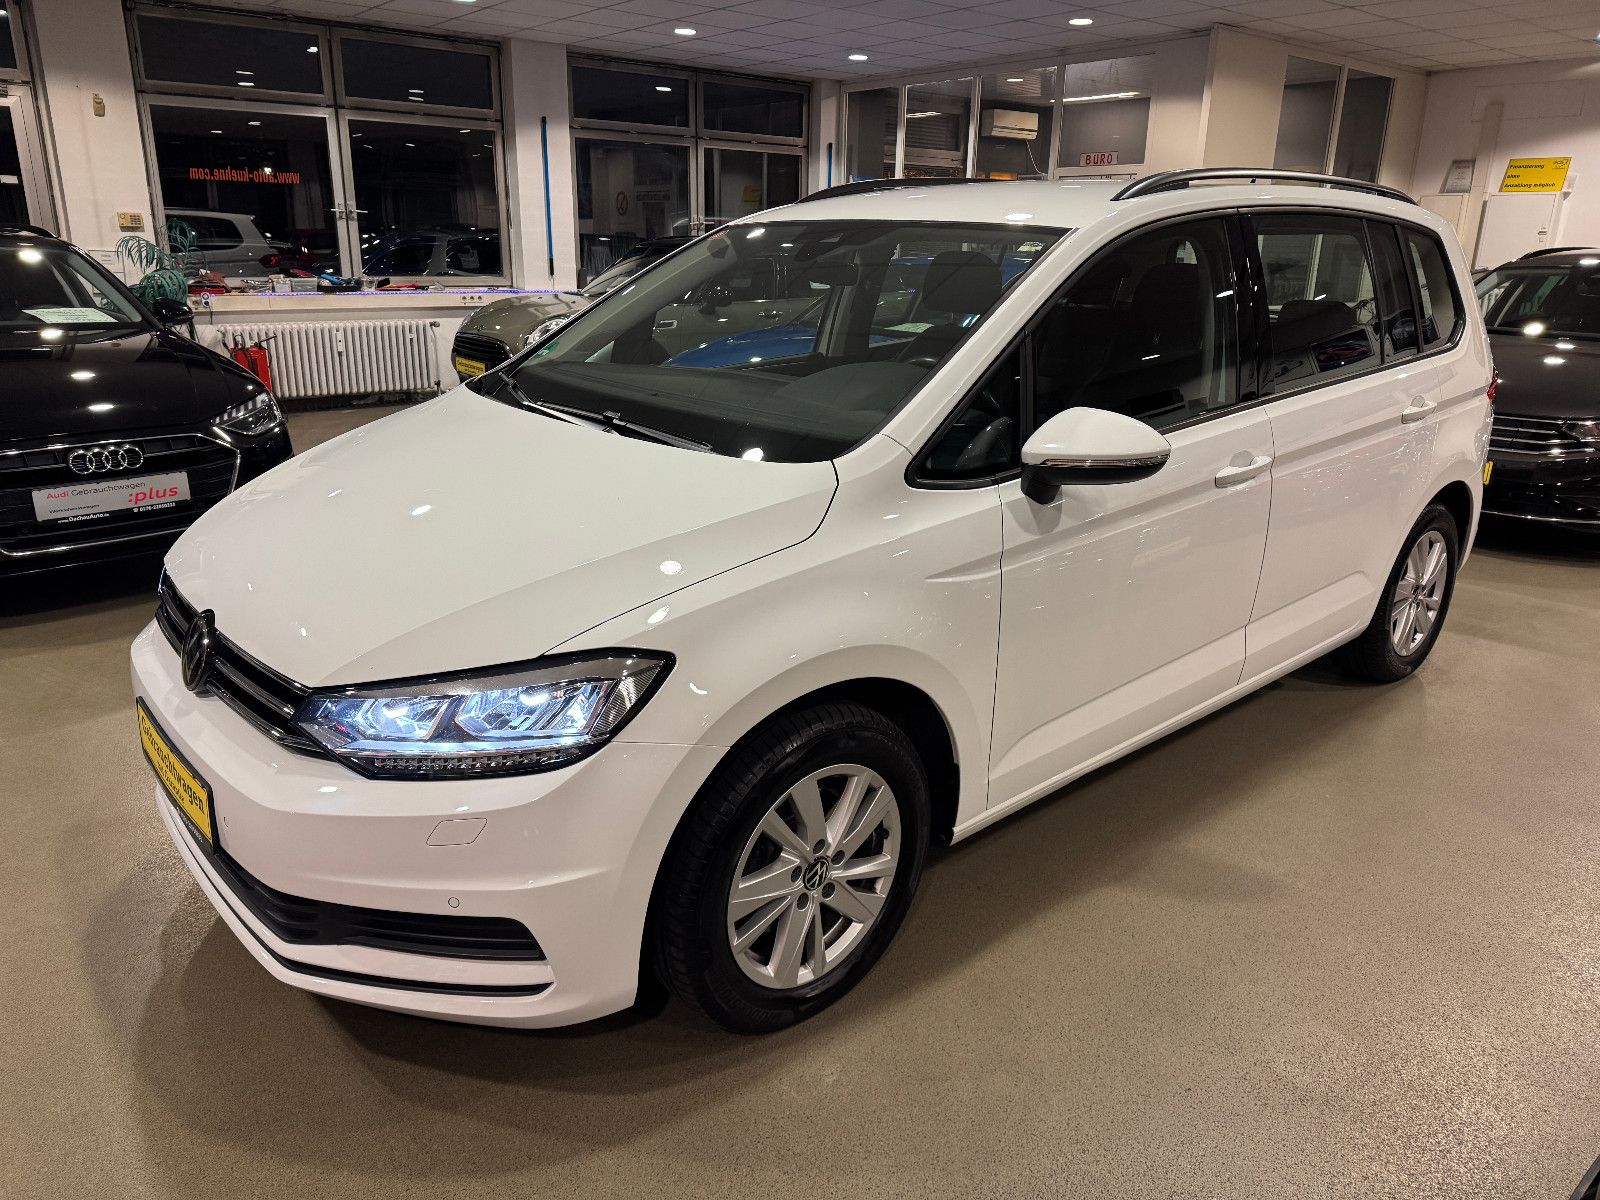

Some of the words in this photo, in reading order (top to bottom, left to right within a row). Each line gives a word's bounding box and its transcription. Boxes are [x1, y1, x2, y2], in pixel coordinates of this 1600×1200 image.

[1085, 153, 1113, 165] BÜRO
[47, 490, 69, 500] Audi
[71, 481, 146, 497] Gebrauchtwagen
